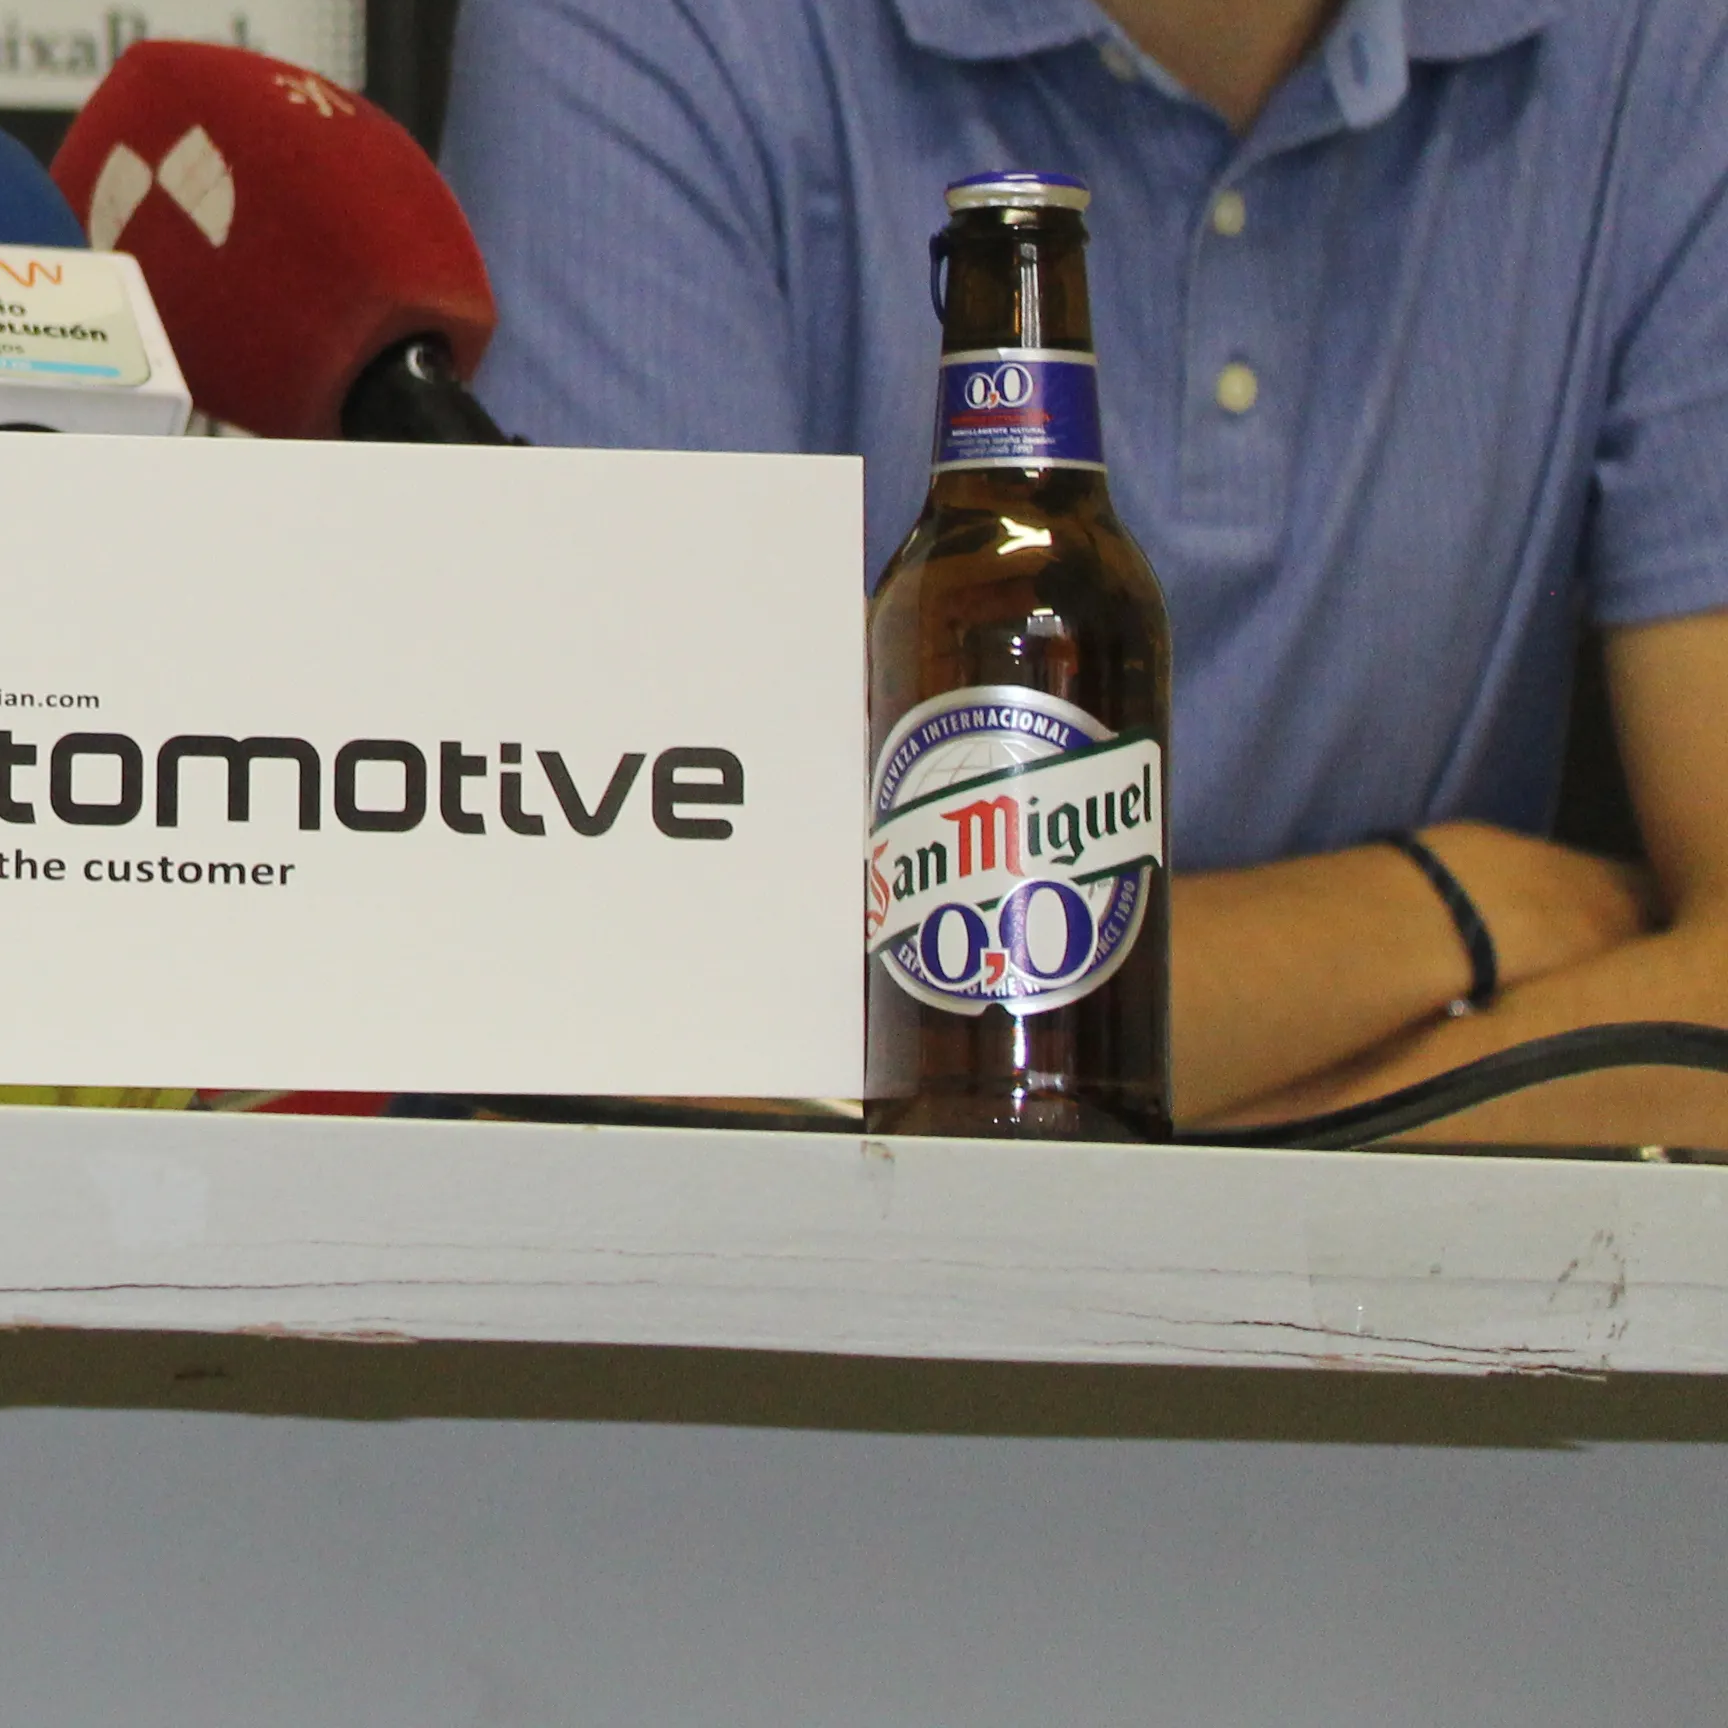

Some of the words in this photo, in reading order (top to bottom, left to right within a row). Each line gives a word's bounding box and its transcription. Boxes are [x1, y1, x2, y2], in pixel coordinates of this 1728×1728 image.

[878, 736, 921, 812] CERVEZA
[921, 708, 1071, 748] INTERNACIONAL
[82, 848, 296, 888] customer
[939, 762, 1153, 878] Miguel
